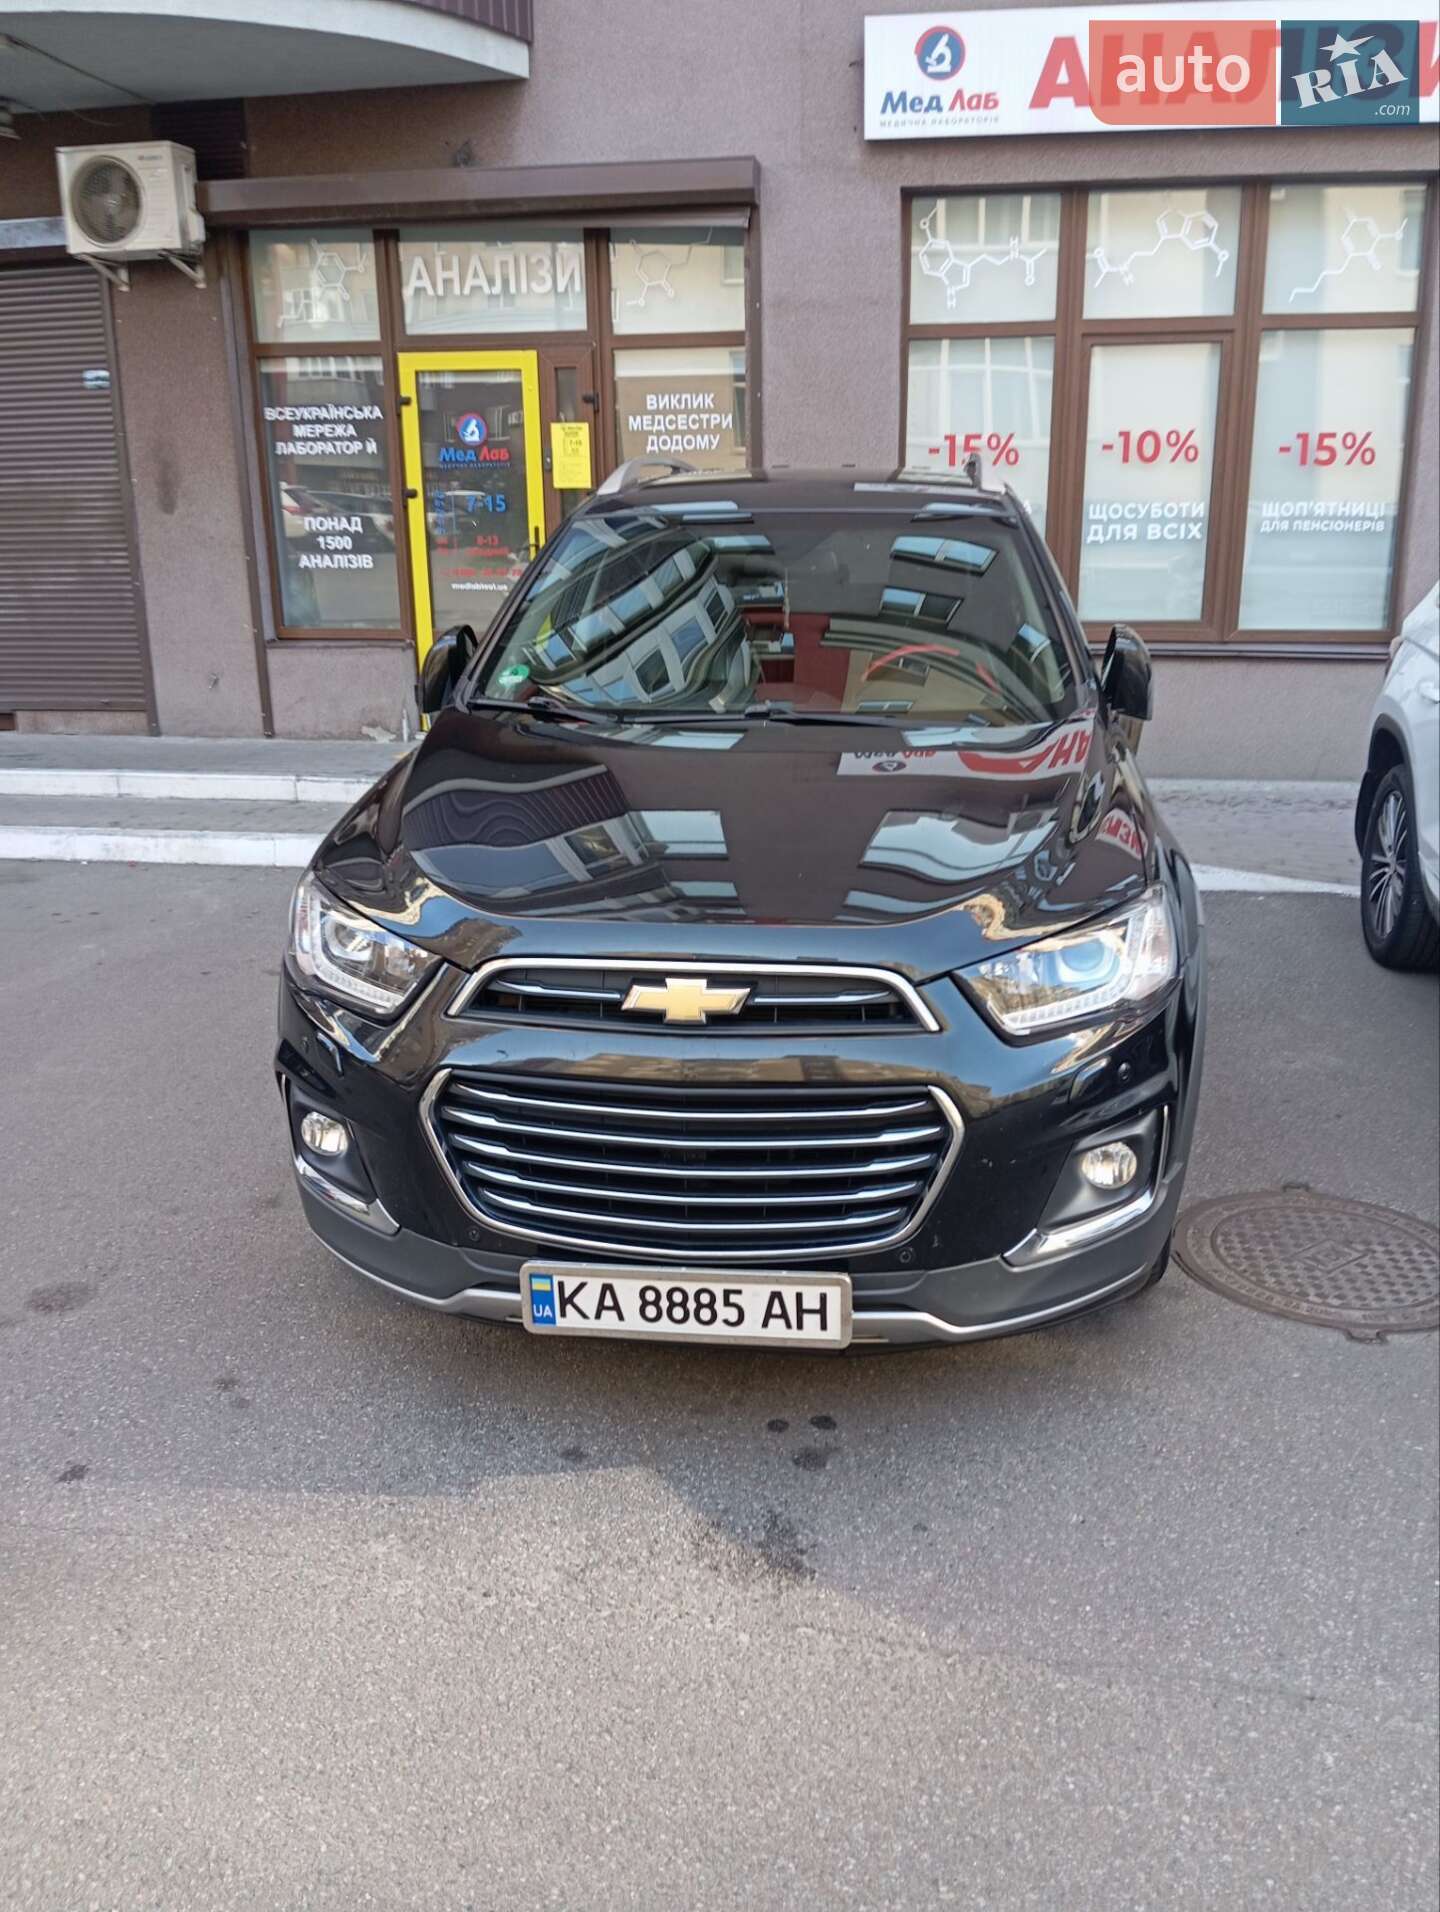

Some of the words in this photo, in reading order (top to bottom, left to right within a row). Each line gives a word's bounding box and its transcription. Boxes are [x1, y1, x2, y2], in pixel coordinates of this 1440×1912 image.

[880, 90, 943, 115] Мед
[948, 87, 999, 112] Лаб
[405, 254, 583, 297] АНАЛІЗИ
[646, 393, 714, 411] ВИКЛИК
[263, 403, 383, 421] ВСЕУКРАЇНСЬКА
[292, 423, 358, 438] МЕРЕЖА
[628, 413, 733, 432] МЕДСЕСТРИ
[646, 434, 720, 453] ДОДОМУ
[1101, 428, 1199, 465] -10%
[1278, 431, 1376, 467] -15%
[439, 447, 476, 462] Мед
[479, 447, 510, 461] Лаб
[466, 494, 506, 513] 7-15
[1088, 501, 1205, 522] ЩОСУБОТИ
[303, 516, 363, 533] ПОНАД
[1086, 522, 1138, 545] ДЛЯ
[1147, 521, 1204, 541] ВСІХ
[1260, 520, 1289, 532] ДЛЯ
[1293, 519, 1385, 532] ПЕНСІОНЕРІВ
[316, 535, 353, 550] 1500
[299, 553, 374, 569] АНАЛІЗІВ
[533, 1304, 553, 1319] UA
[557, 1280, 625, 1322] KA
[638, 1285, 745, 1327] 8885
[761, 1290, 828, 1332] AH
